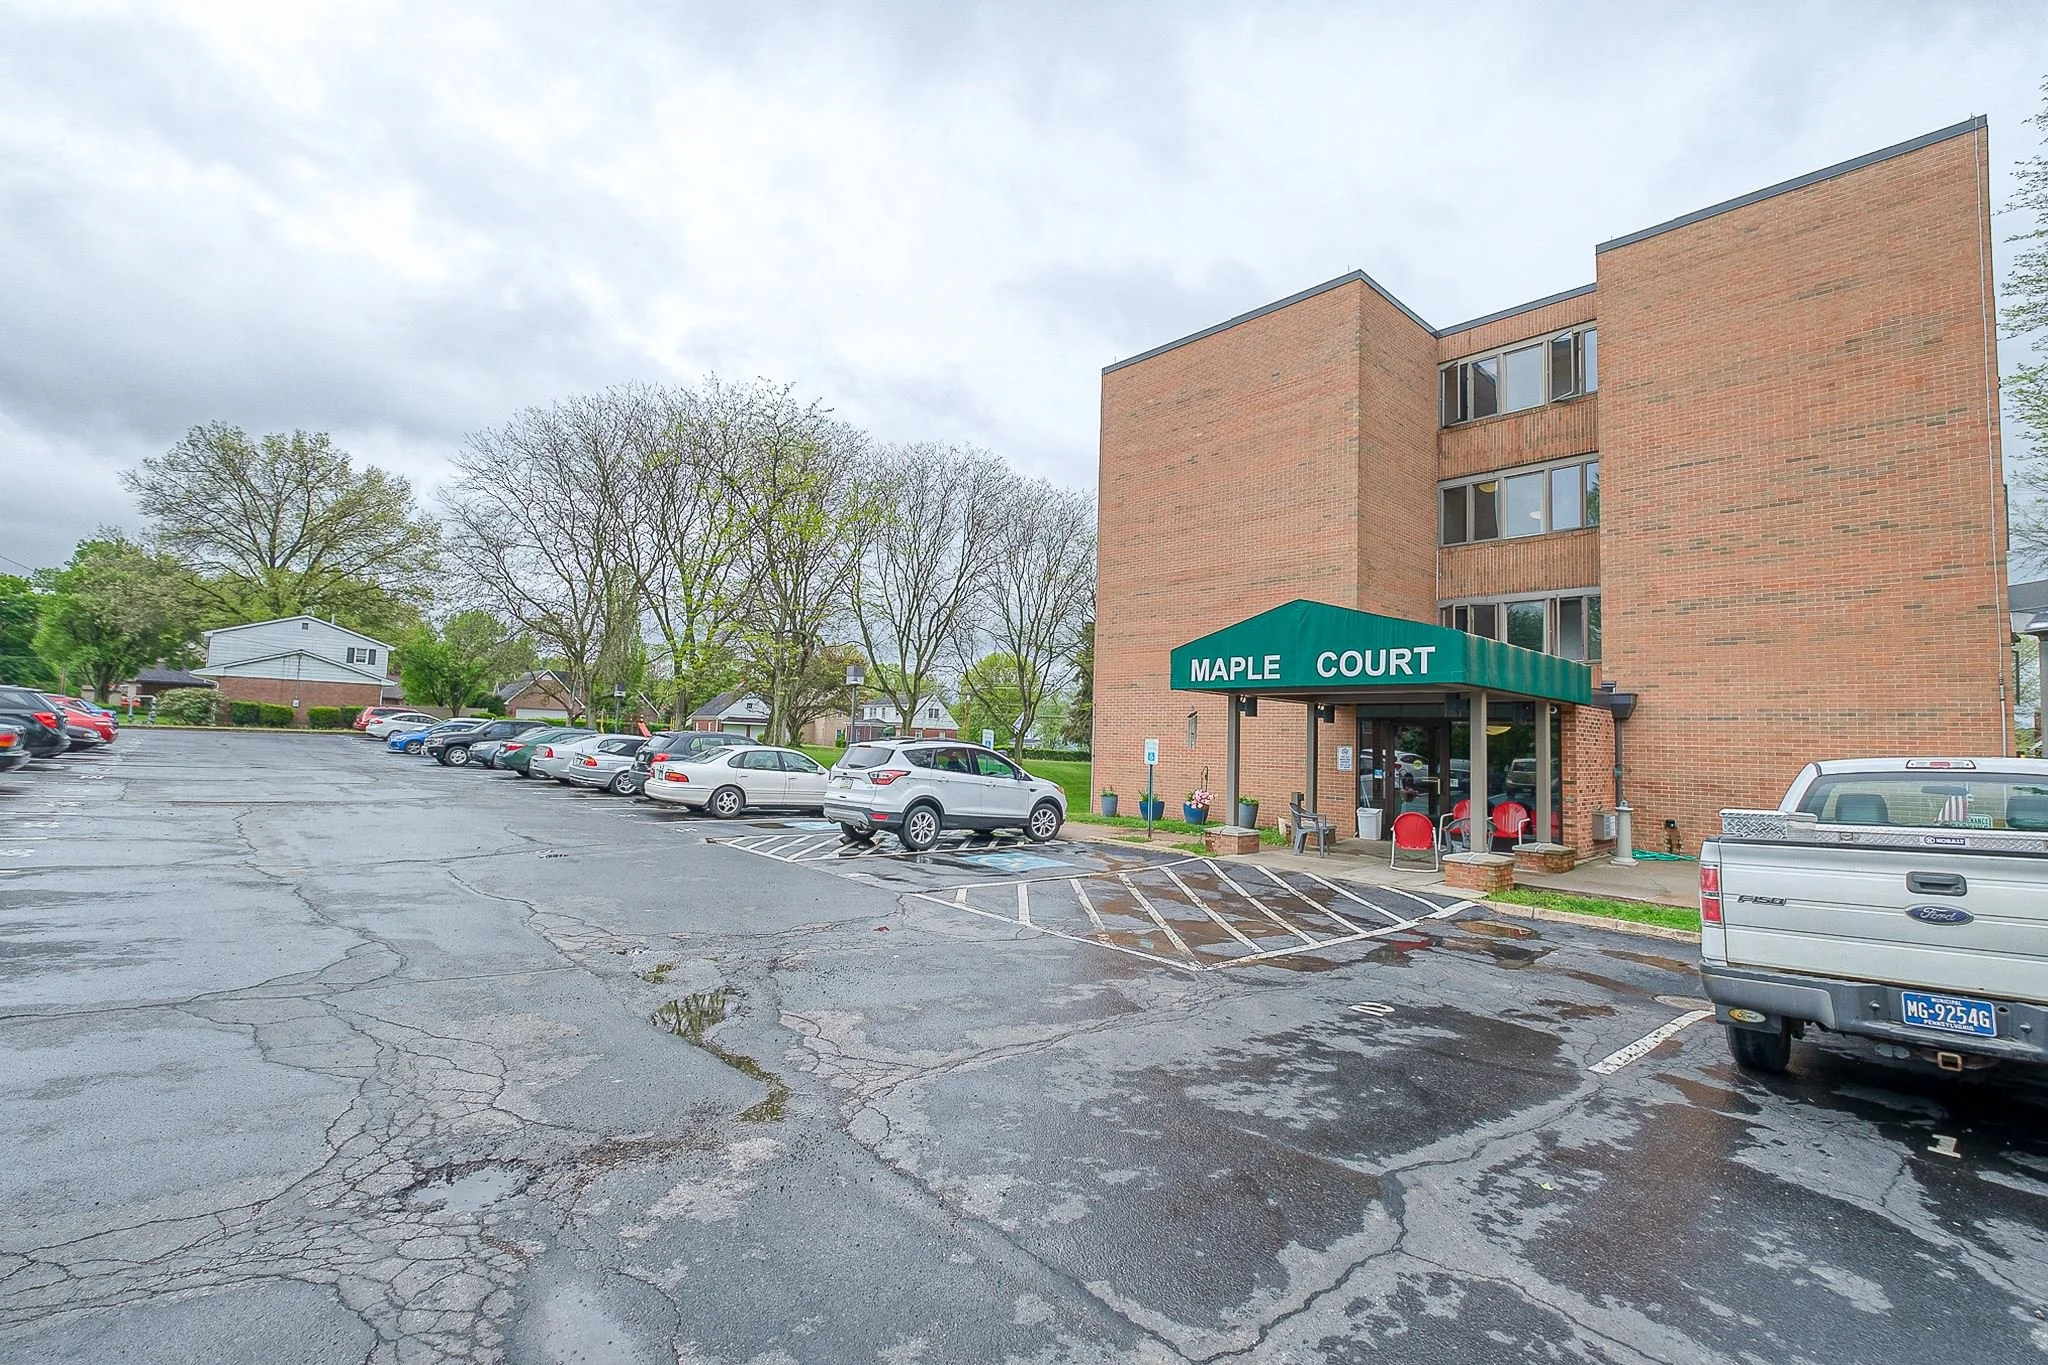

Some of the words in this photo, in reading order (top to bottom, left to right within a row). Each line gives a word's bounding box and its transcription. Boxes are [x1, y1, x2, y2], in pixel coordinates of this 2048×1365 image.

[1190, 654, 1281, 682] MAPLE
[1316, 646, 1436, 678] COURT
[1920, 907, 1957, 921] Ford
[1930, 998, 1962, 1007] MUNICIPAL
[1906, 1000, 1991, 1028] MG-9254G
[1923, 1019, 1975, 1032] PENNSYLVANIA
